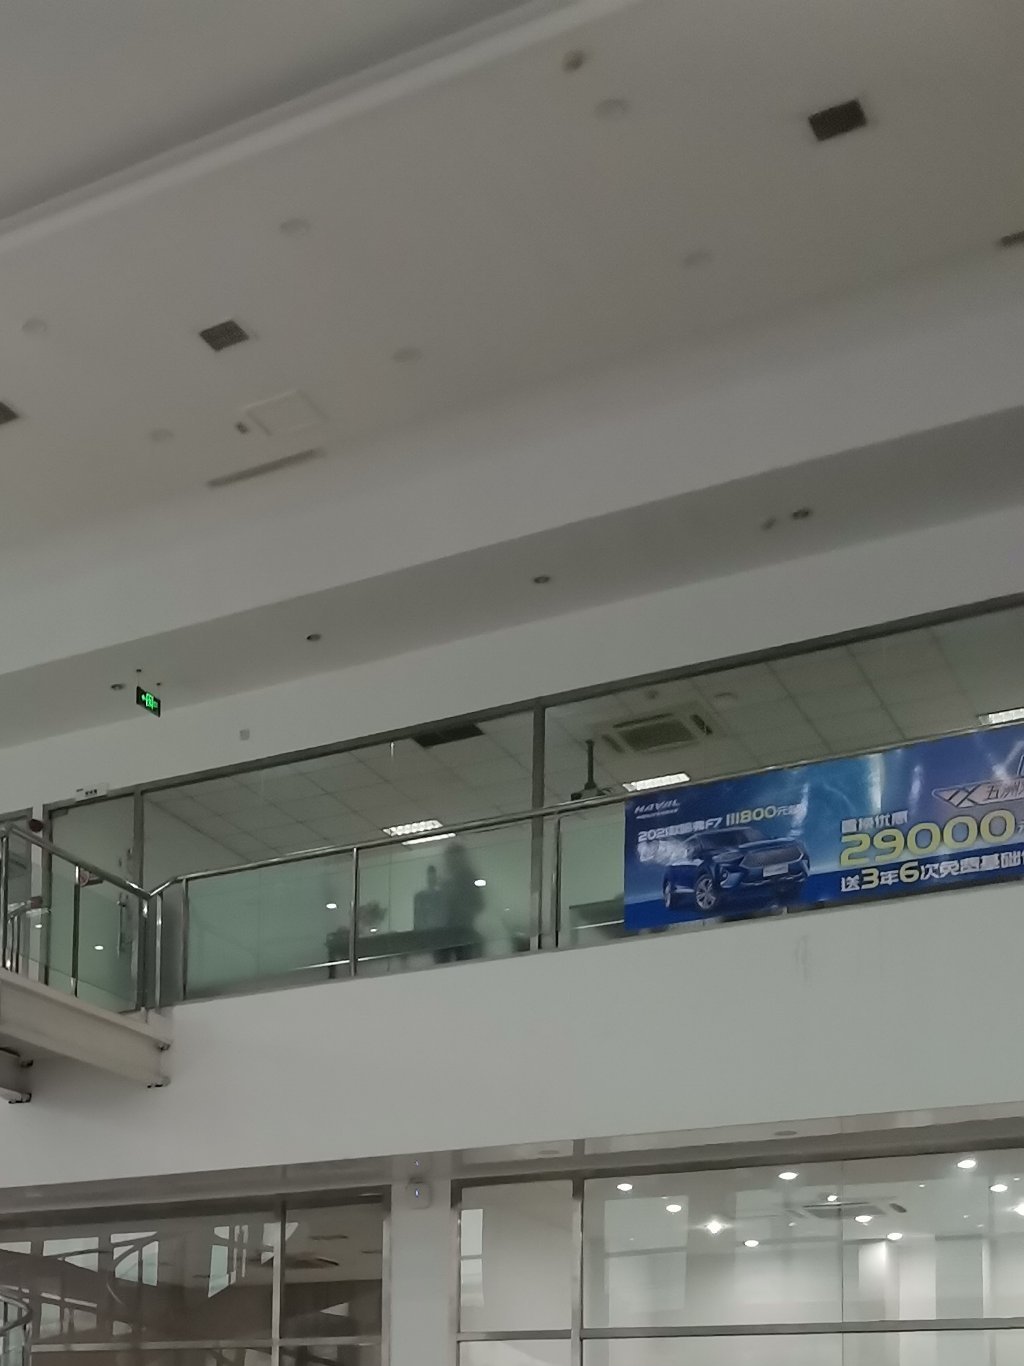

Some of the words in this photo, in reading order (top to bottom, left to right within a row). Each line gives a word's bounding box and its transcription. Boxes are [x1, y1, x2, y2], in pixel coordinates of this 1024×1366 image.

[840, 849, 1024, 893] 送3年6次免费基础
